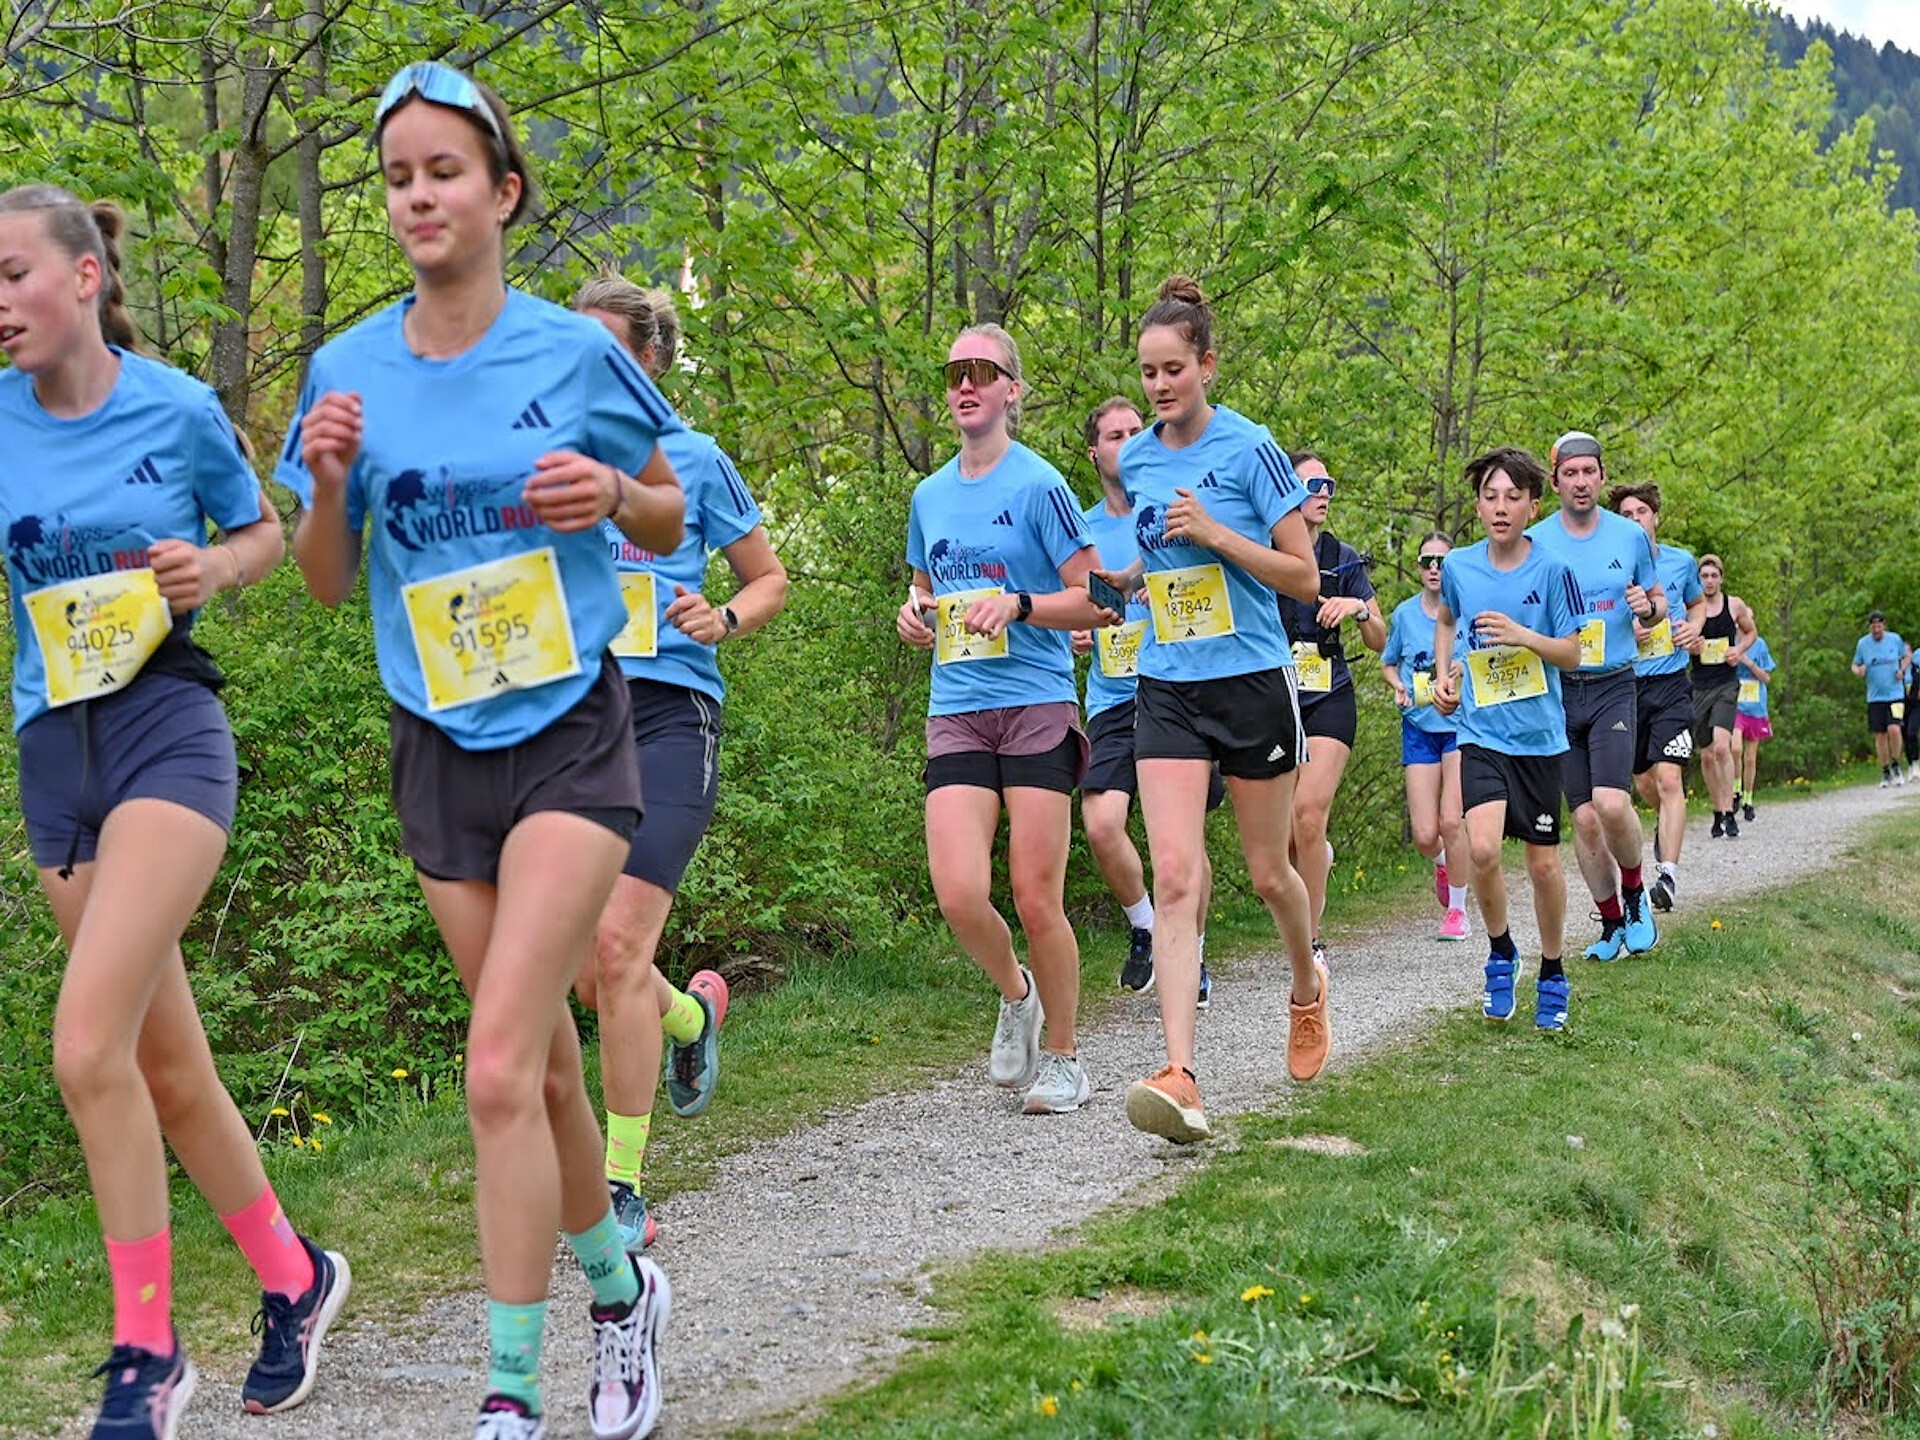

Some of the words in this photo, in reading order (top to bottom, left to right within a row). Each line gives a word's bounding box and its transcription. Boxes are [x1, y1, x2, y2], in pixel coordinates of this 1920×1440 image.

[412, 506, 500, 544] WORLD
[502, 503, 545, 531] RU
[31, 552, 113, 578] WORLD
[113, 547, 152, 571] RU
[939, 563, 980, 580] WORLD
[980, 562, 1006, 579] RUN
[1165, 597, 1212, 617] 187842
[1596, 600, 1615, 612] RUN
[67, 621, 134, 659] 94025
[450, 613, 529, 657] 91595
[1486, 665, 1528, 685] 292574
